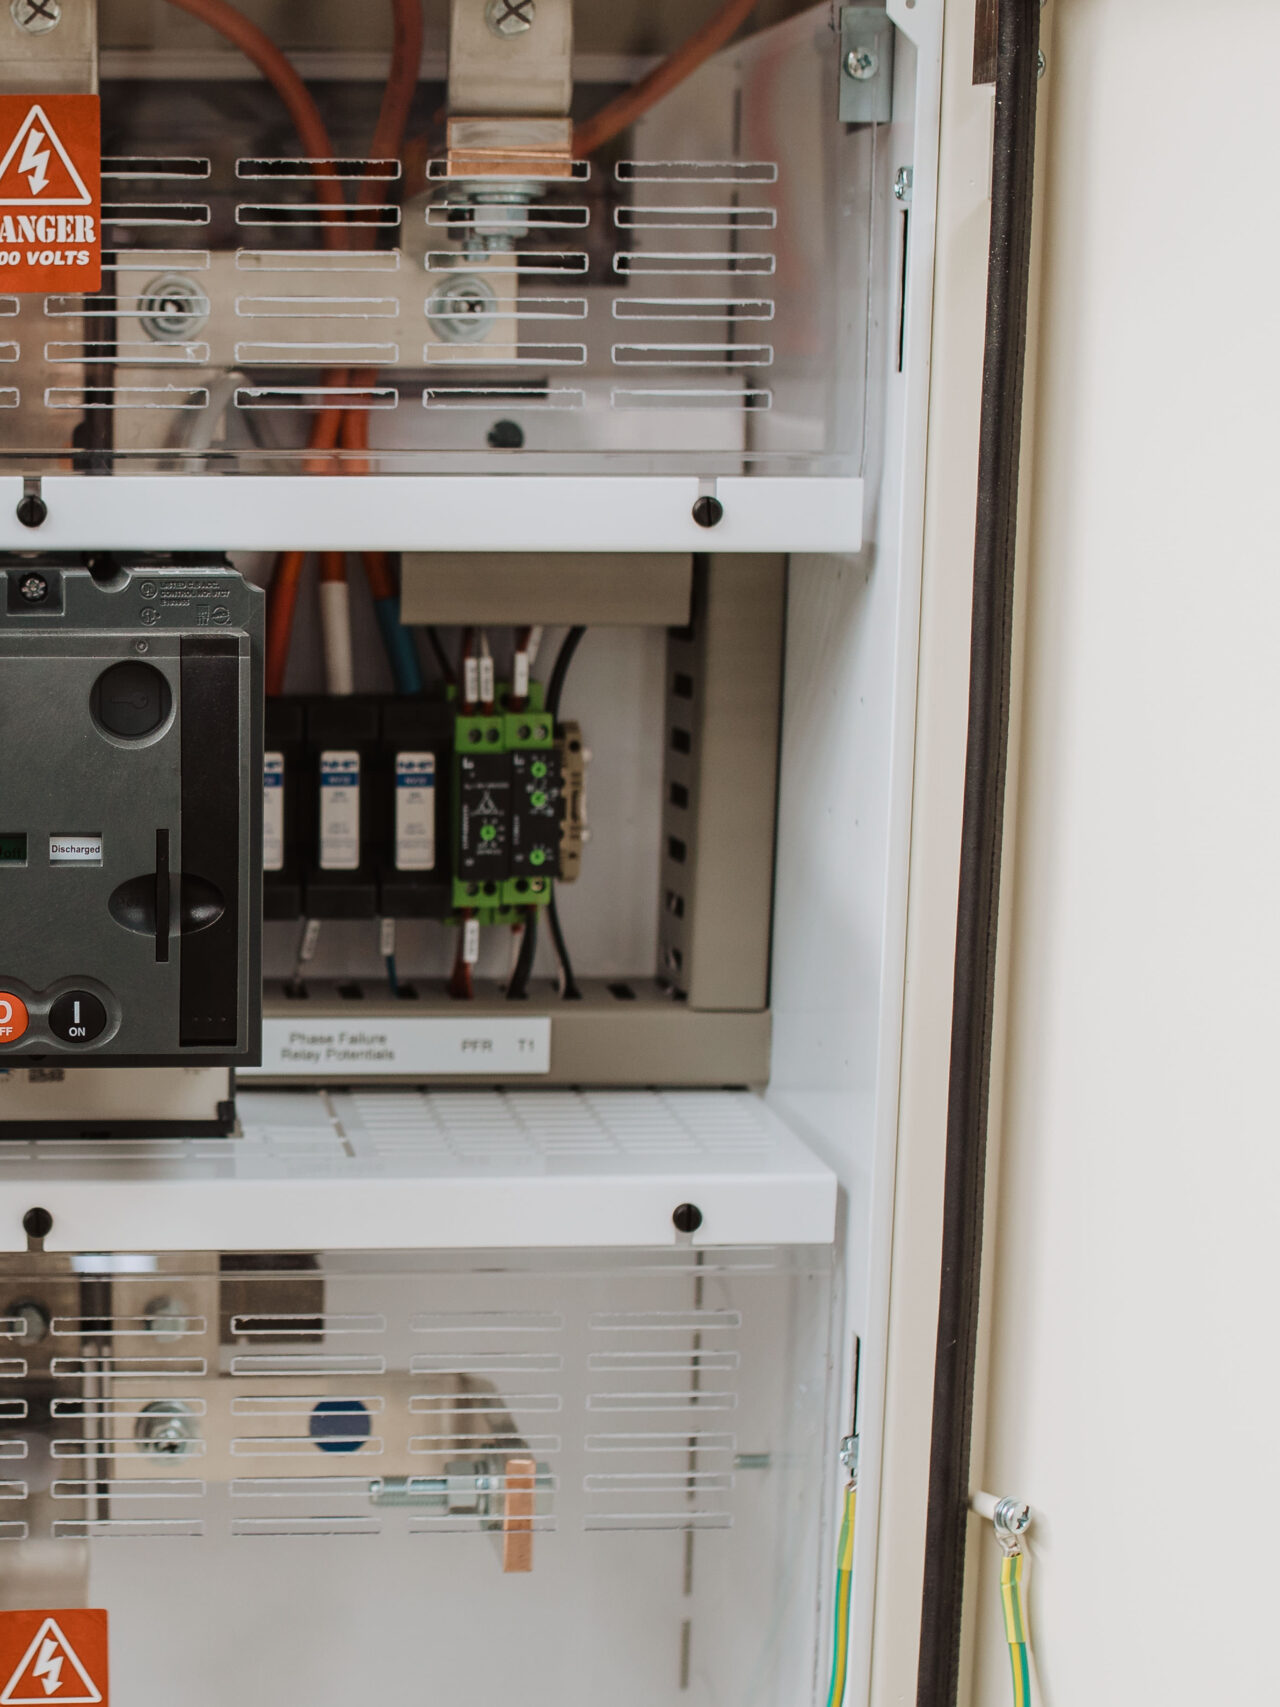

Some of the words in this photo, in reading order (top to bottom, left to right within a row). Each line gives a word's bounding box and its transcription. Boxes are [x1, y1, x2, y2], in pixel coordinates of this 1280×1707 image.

[26, 250, 90, 266] VOLTS
[51, 844, 101, 855] Discharged
[68, 1027, 85, 1037] ON
[289, 1032, 334, 1045] Phase
[338, 1032, 387, 1045] Failure
[461, 1039, 494, 1053] PFR
[517, 1039, 535, 1052] T1
[280, 1048, 321, 1063] Relay
[325, 1048, 395, 1061] Potentials
